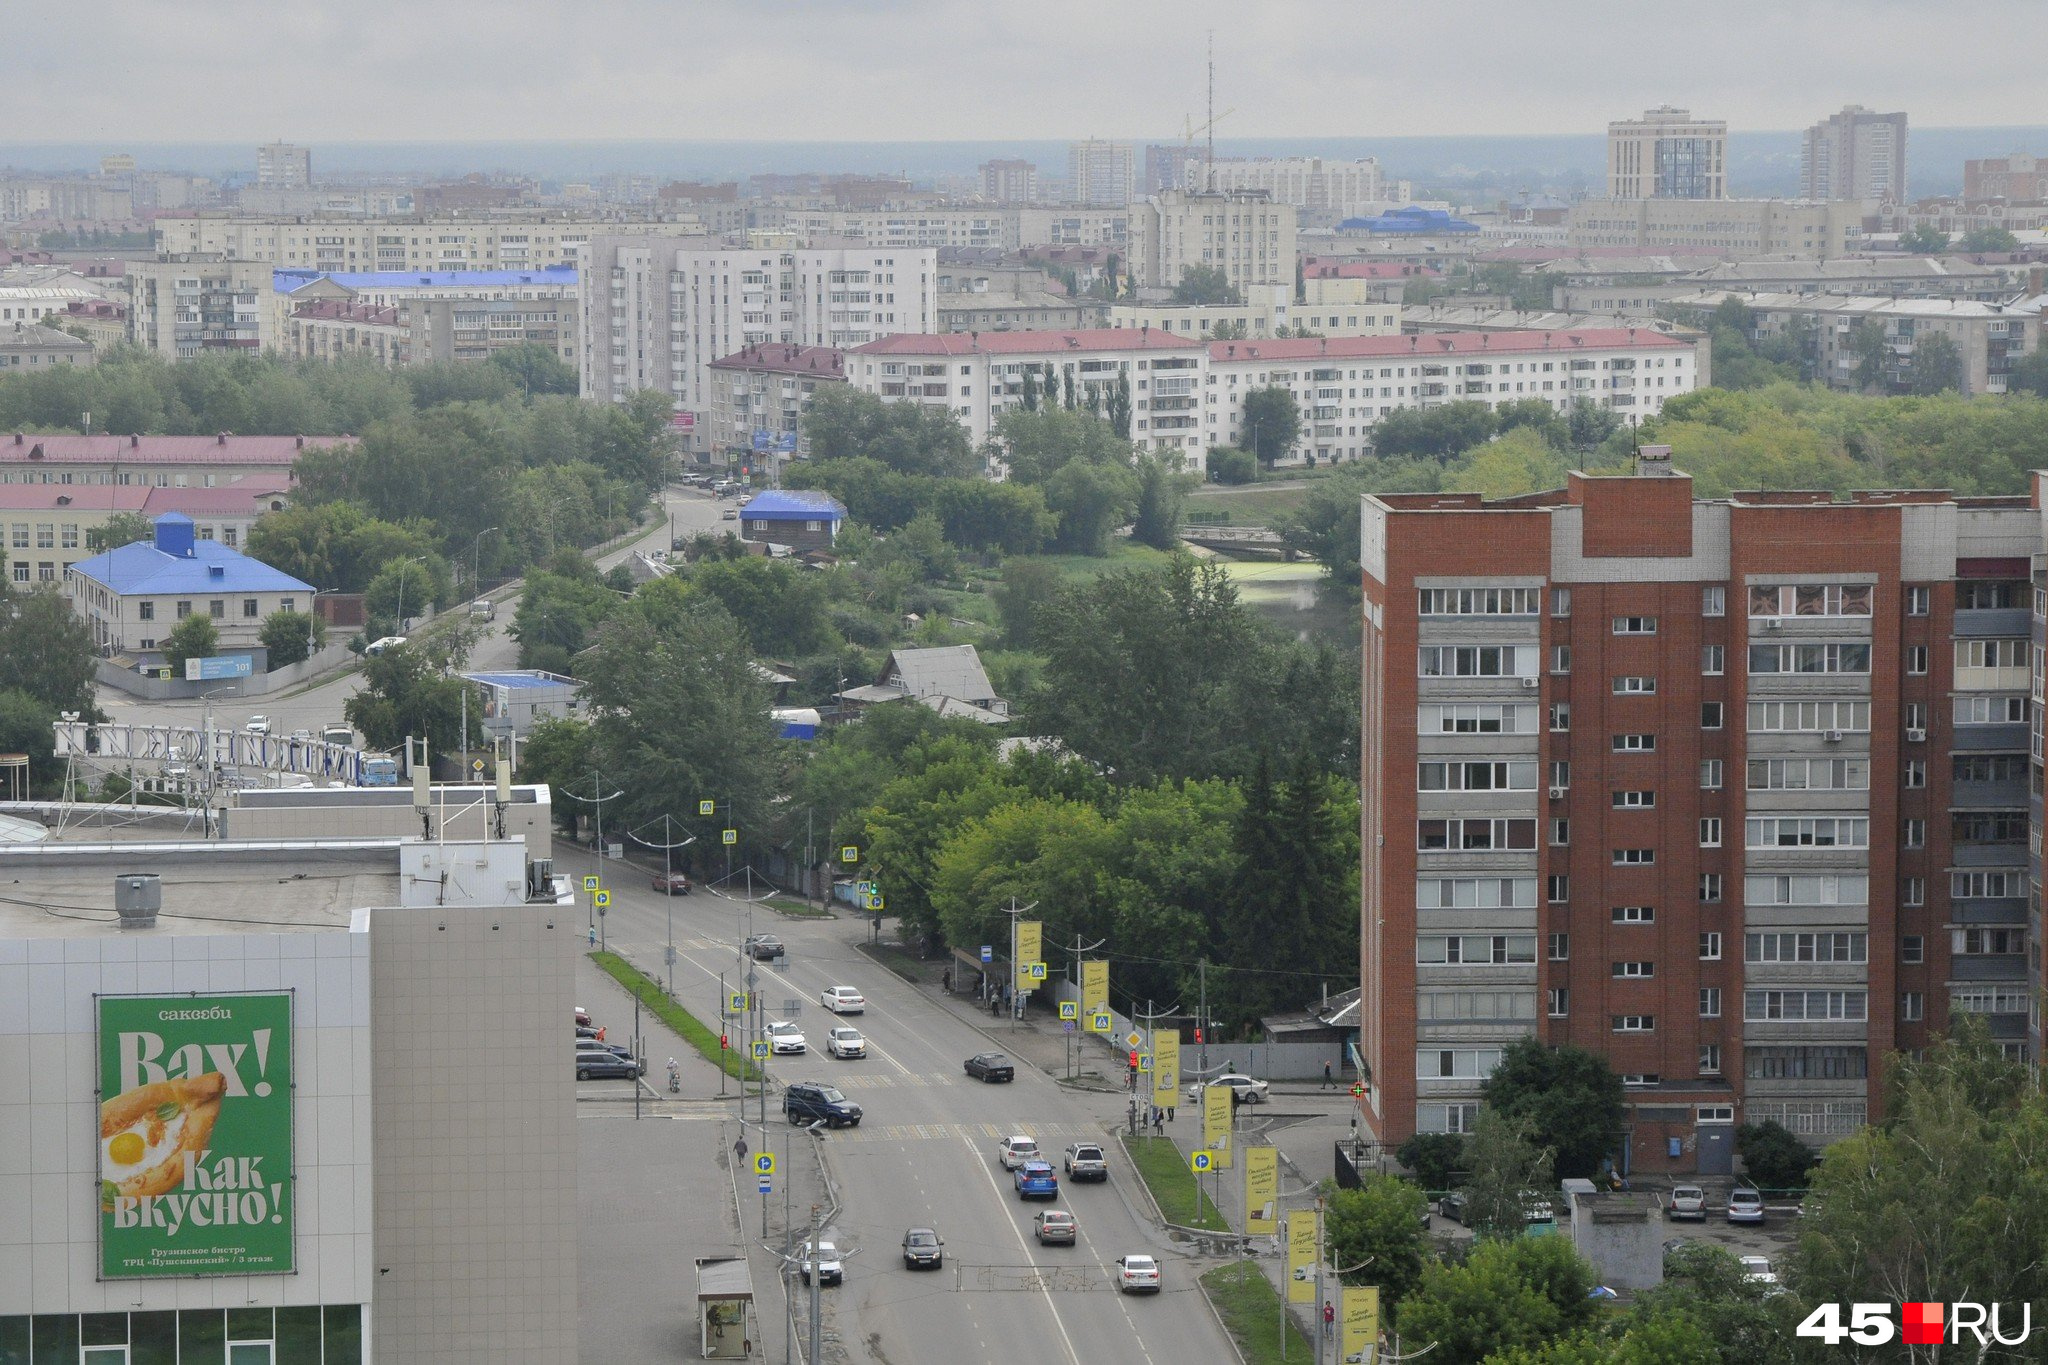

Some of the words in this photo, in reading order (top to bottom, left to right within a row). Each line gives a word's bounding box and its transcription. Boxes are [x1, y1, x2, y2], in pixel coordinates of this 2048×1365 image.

[118, 1028, 273, 1098] Вах!
[182, 1150, 265, 1191] Как
[113, 1183, 283, 1236] вкусно!
[122, 1258, 145, 1267] ТРЦ
[151, 1248, 209, 1257] Грузинское
[211, 1246, 246, 1255] бистро
